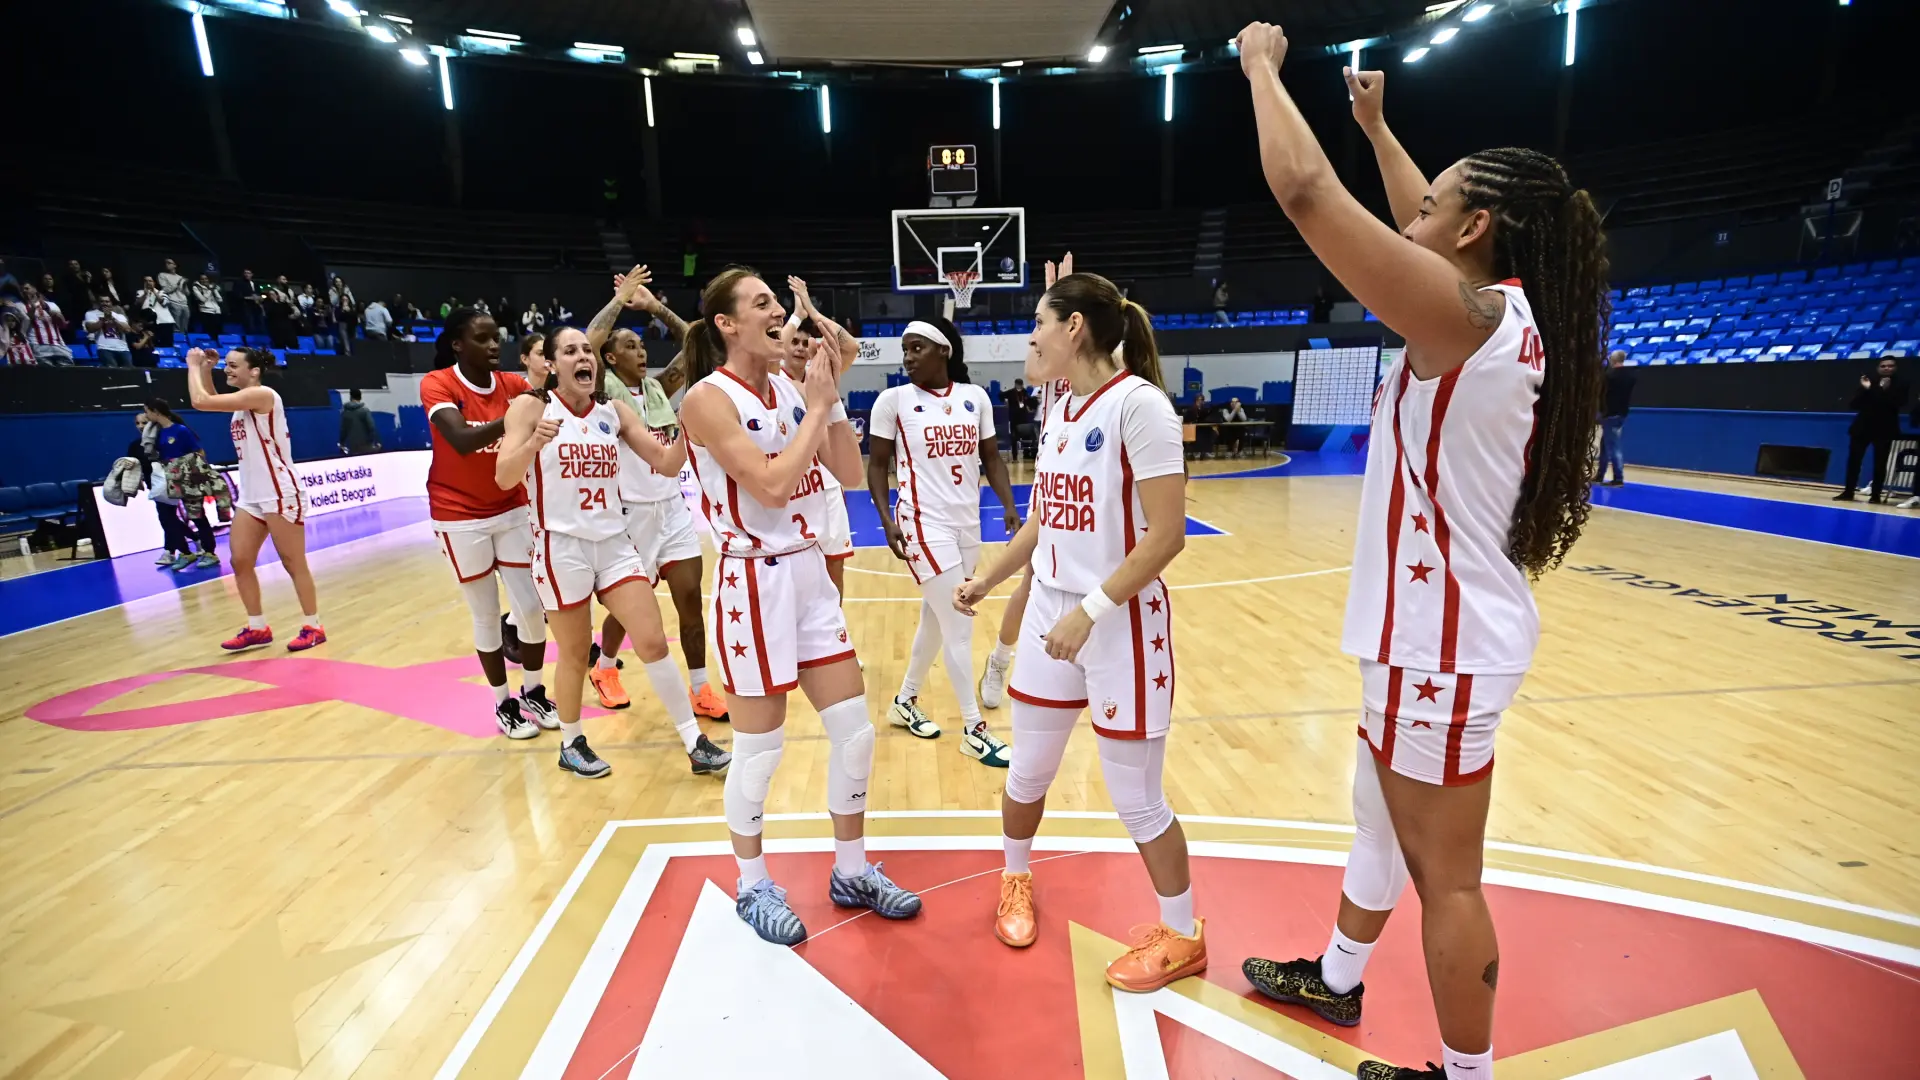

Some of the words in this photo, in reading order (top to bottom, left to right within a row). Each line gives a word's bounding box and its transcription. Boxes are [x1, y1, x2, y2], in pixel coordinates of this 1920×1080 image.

[857, 348, 880, 358] STORY
[924, 424, 977, 441] CRVENA
[558, 443, 618, 461] CRVENA
[927, 440, 979, 459] ZVEZDA
[325, 466, 372, 483] košarkaška
[559, 461, 618, 479] ZVEZDA
[951, 465, 963, 485] 5
[310, 491, 339, 508] koledž
[342, 484, 377, 502] Beograd
[1039, 472, 1093, 503] RVENA
[579, 488, 607, 510] 24
[791, 513, 816, 539] 2
[1039, 501, 1095, 532] VEZDA
[1567, 565, 1920, 660] UROLEAGUE
